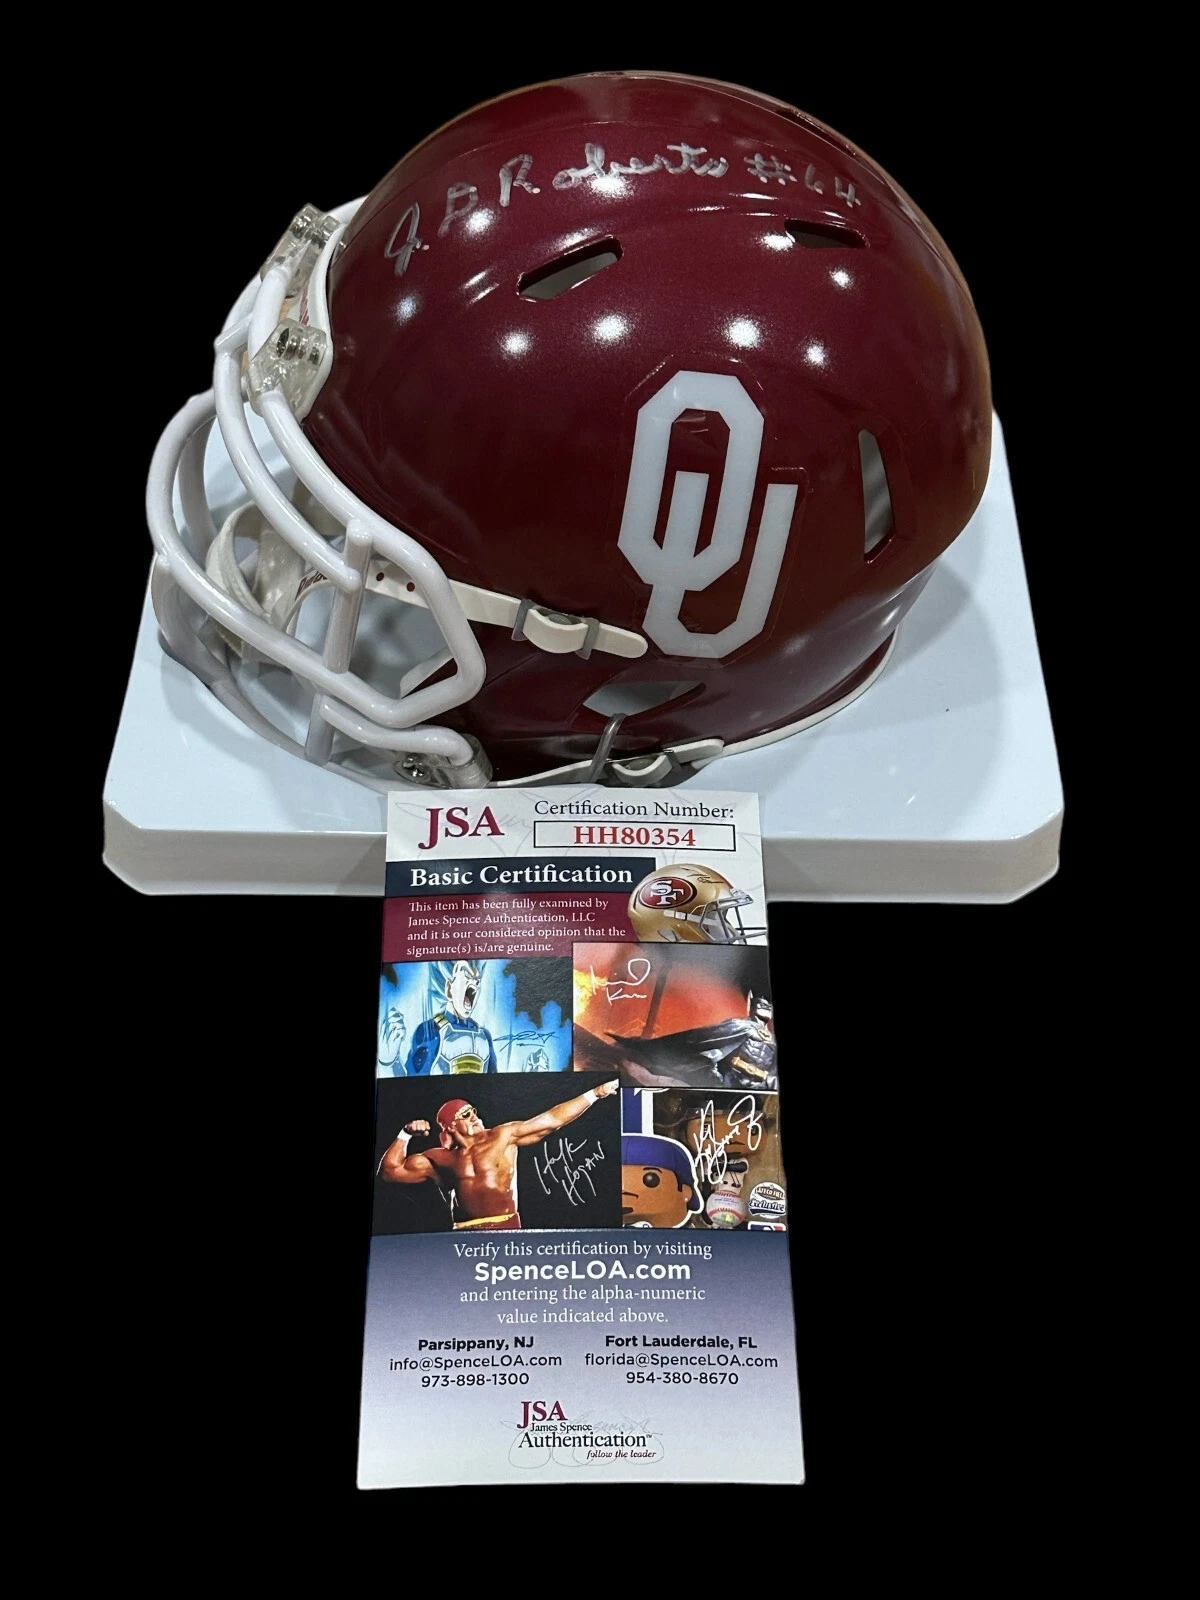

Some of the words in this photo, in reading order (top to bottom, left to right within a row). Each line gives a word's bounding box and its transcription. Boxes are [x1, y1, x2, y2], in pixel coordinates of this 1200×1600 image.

[617, 370, 798, 658] OU
[534, 799, 648, 817] Certification
[654, 801, 734, 818] Number:
[417, 805, 505, 850] JSA
[574, 826, 697, 847] HH80354
[410, 867, 473, 887] Basic
[480, 864, 633, 884] Certification
[409, 902, 432, 912] This
[435, 901, 459, 911] item
[462, 900, 480, 910] has
[483, 899, 508, 909] been
[512, 898, 536, 911] fully
[539, 898, 592, 909] examined
[596, 898, 609, 909] by
[408, 916, 440, 928] James
[442, 915, 481, 927] Spence
[484, 913, 569, 923] Authentication,
[572, 912, 596, 922] LLC
[407, 930, 428, 940] and
[431, 930, 439, 939] it
[441, 930, 450, 939] is
[453, 930, 473, 939] our
[475, 927, 535, 938] considered
[538, 929, 580, 938] opinion
[584, 927, 605, 936] that
[608, 926, 626, 937] the
[406, 943, 471, 958] signature(s)
[474, 943, 504, 953] is/are
[507, 942, 554, 955] genuine.
[454, 1242, 500, 1261] Verify
[504, 1241, 532, 1256] this
[537, 1240, 628, 1255] certification
[633, 1240, 652, 1259] by
[656, 1241, 713, 1260] visiting
[474, 1260, 691, 1285] SpenceLOA.com
[460, 1286, 489, 1302] and
[493, 1286, 558, 1305] entering
[562, 1285, 587, 1300] the
[591, 1285, 706, 1304] alpha-numeric
[497, 1308, 538, 1324] value
[543, 1308, 614, 1323] indicated
[619, 1308, 669, 1323] above.
[418, 1338, 510, 1352] Parsippany,
[514, 1336, 534, 1348] NJ
[605, 1335, 638, 1347] Fort
[642, 1335, 734, 1350] Lauderdale,
[738, 1336, 758, 1348] FL
[389, 1354, 563, 1372] info@SpenceLOA.com
[584, 1353, 778, 1368] florida@SpenceLOA.com
[421, 1373, 530, 1388] 973-898-1300
[626, 1371, 739, 1385] 954-380-8670
[517, 1400, 568, 1429] JSA
[530, 1423, 558, 1432] James
[559, 1422, 593, 1433] Spence
[586, 1450, 613, 1460] follow
[615, 1450, 628, 1458] the
[630, 1450, 657, 1458] leader
